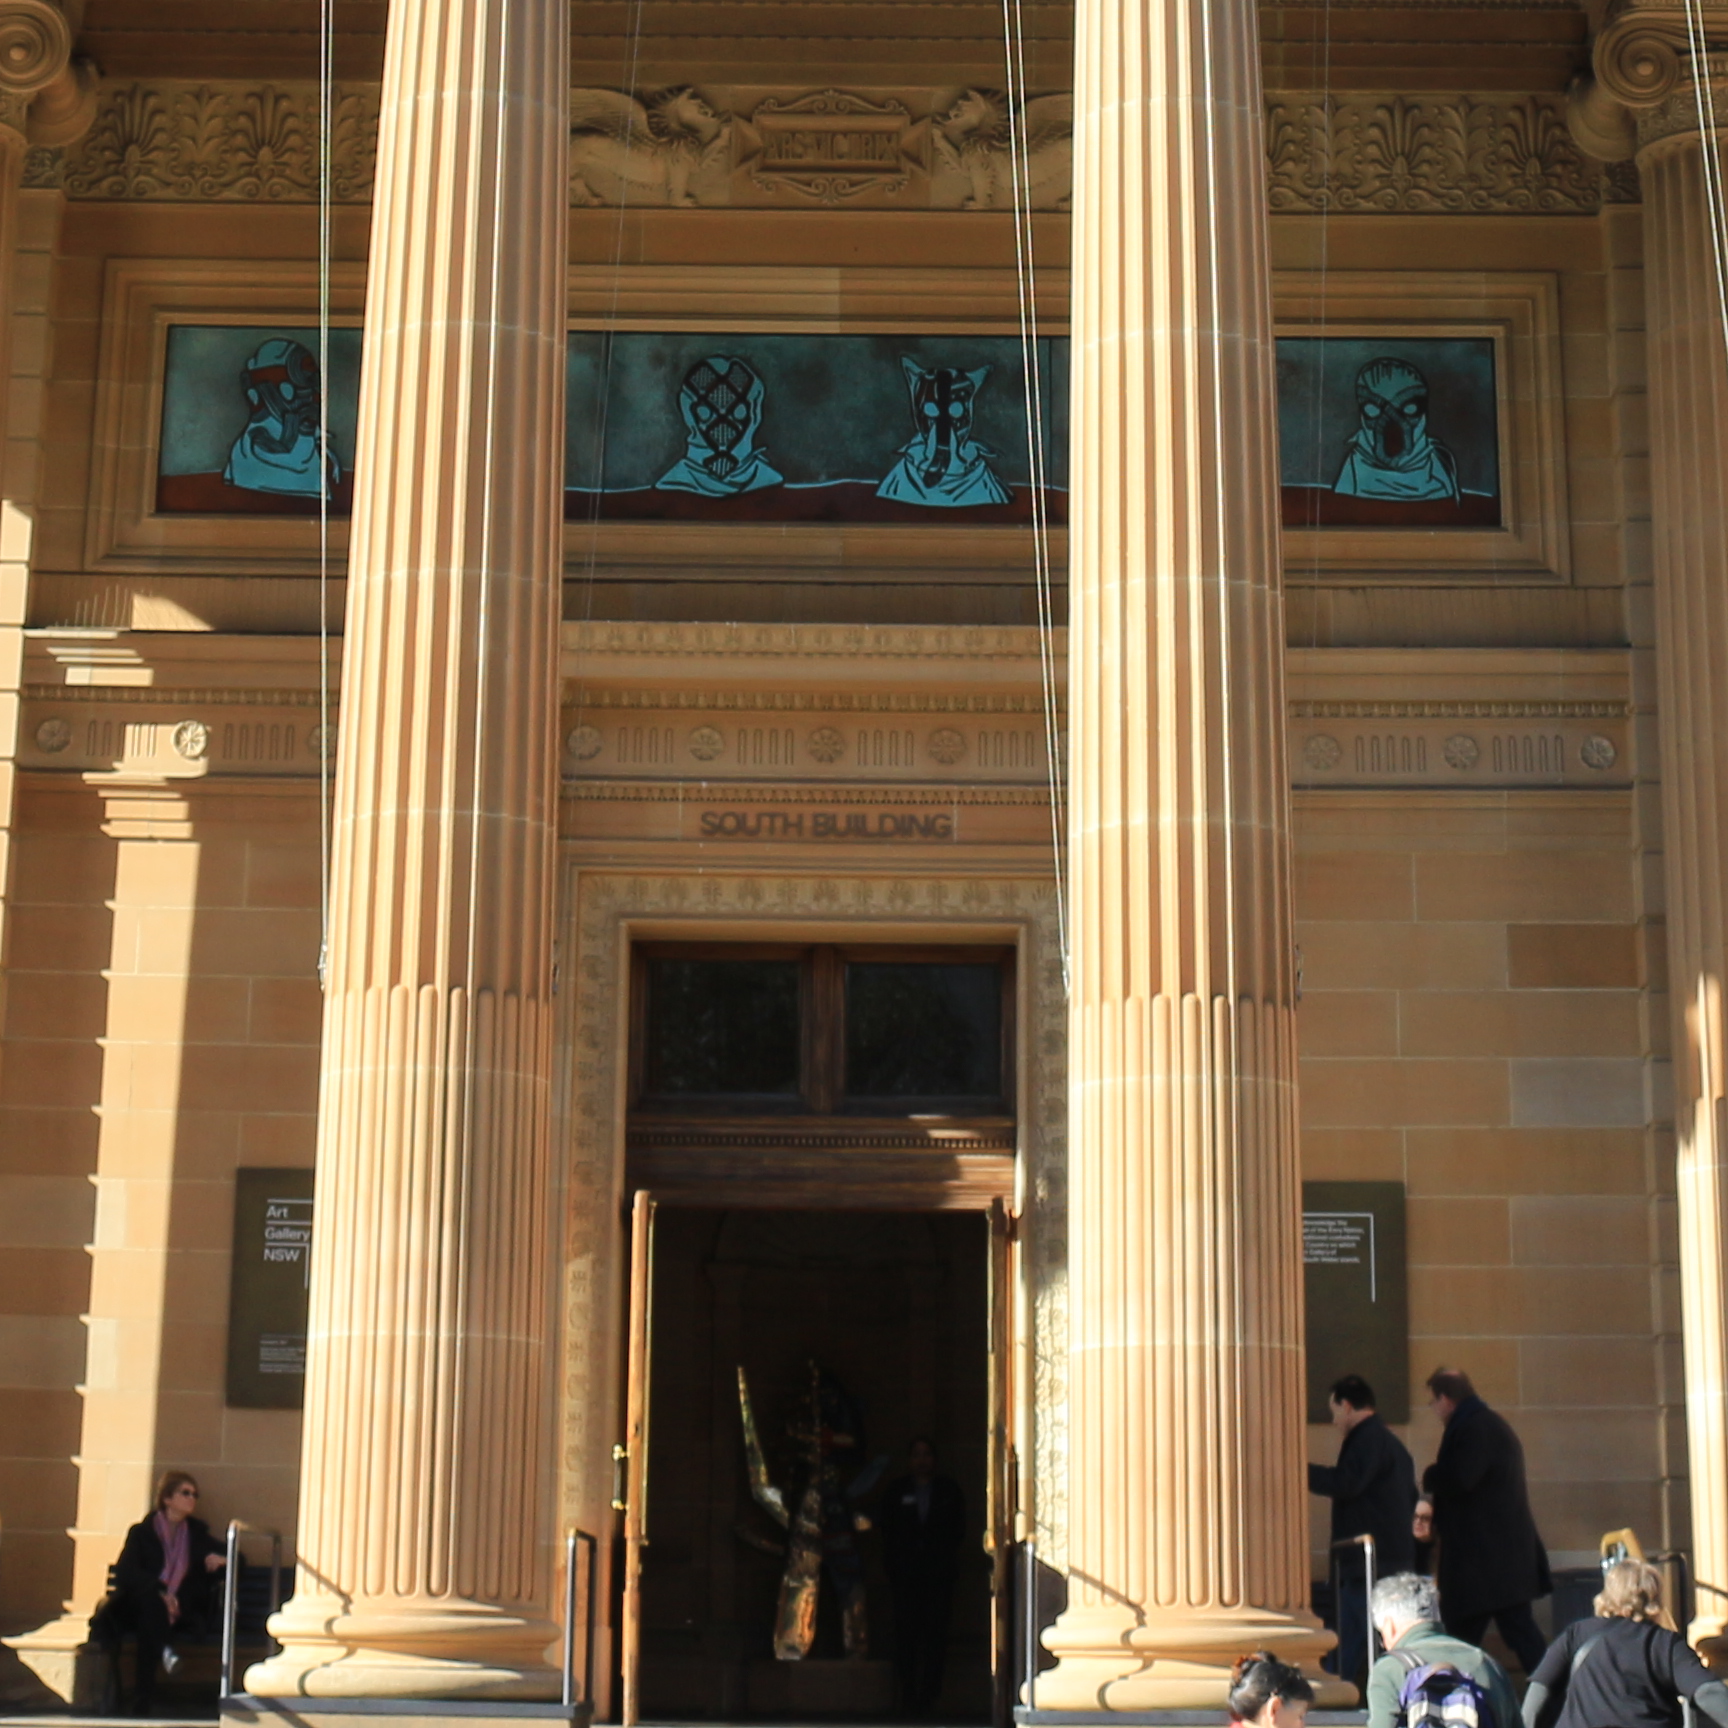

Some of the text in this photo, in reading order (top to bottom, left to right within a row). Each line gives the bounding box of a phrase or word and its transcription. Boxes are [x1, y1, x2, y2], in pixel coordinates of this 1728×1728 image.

[700, 811, 953, 840] SOUTH BUILDING
[266, 1205, 289, 1218] Art
[264, 1227, 311, 1242] Gallery
[263, 1248, 301, 1262] NSW
